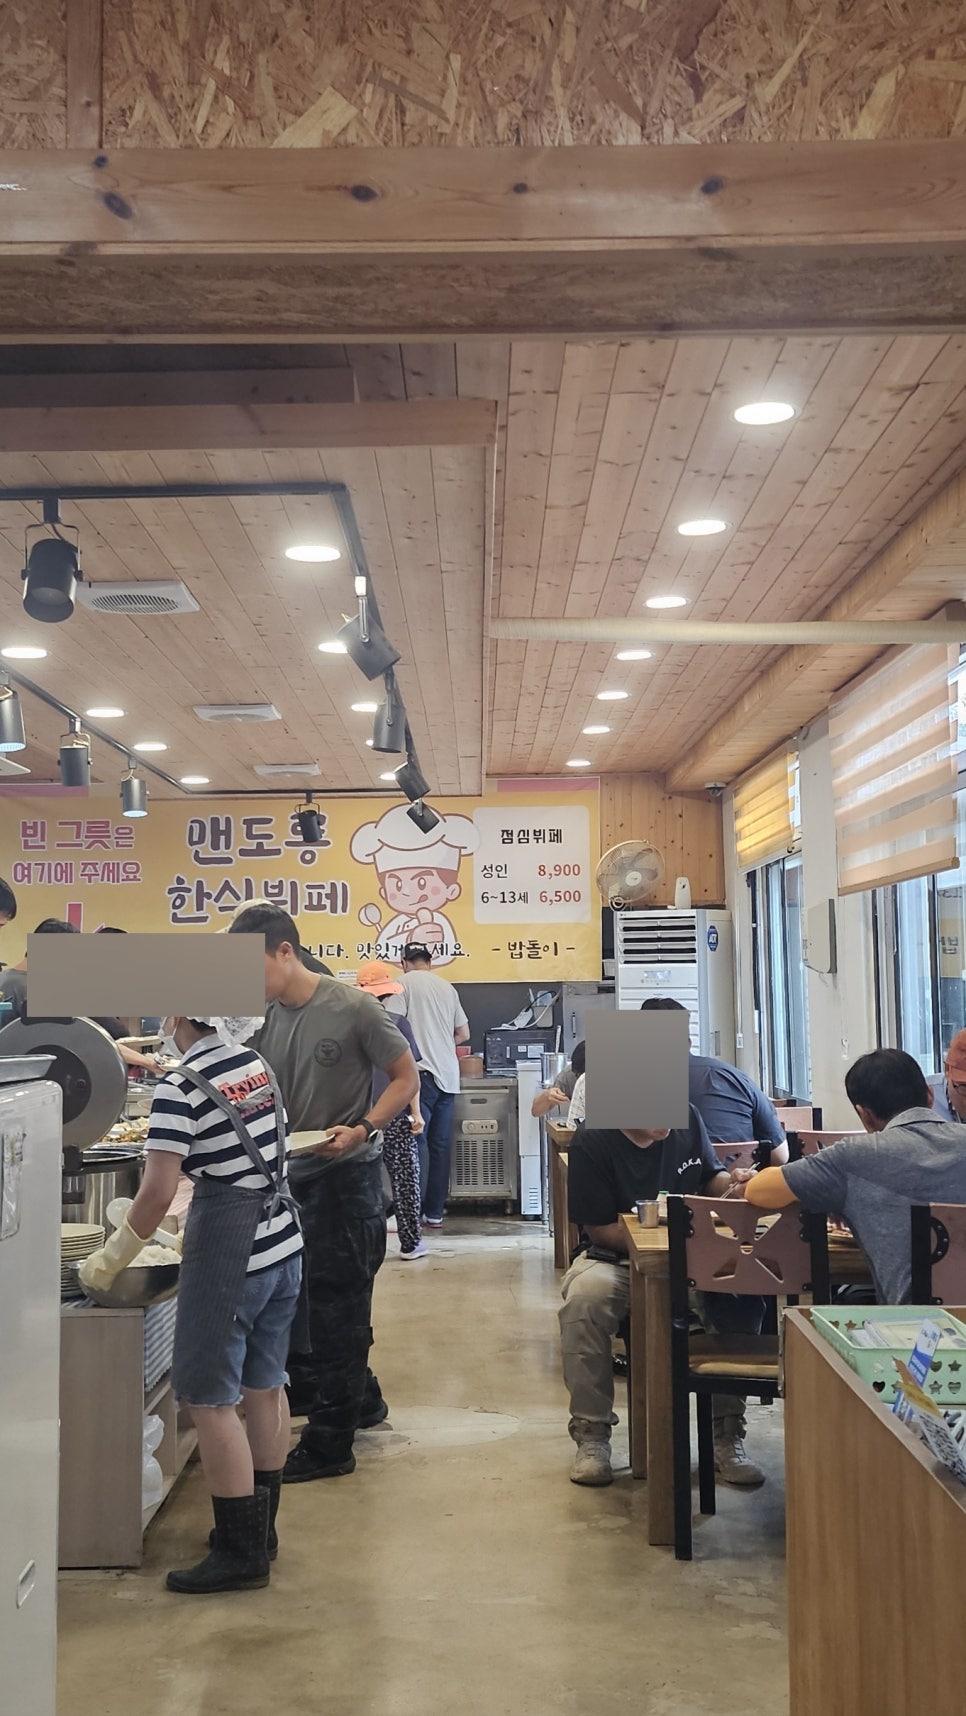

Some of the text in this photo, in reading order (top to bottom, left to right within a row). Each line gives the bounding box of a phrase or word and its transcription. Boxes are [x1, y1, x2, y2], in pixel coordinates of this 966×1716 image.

[20, 818, 135, 850] 빈 그릇은
[187, 815, 332, 867] 맨도롱
[500, 828, 563, 845] 점심뷔페
[12, 861, 142, 885] 여기에 주세요
[480, 863, 582, 879] 성인 8,900
[481, 890, 582, 906] 6~13세 6,500
[218, 1072, 271, 1100] Tryin
